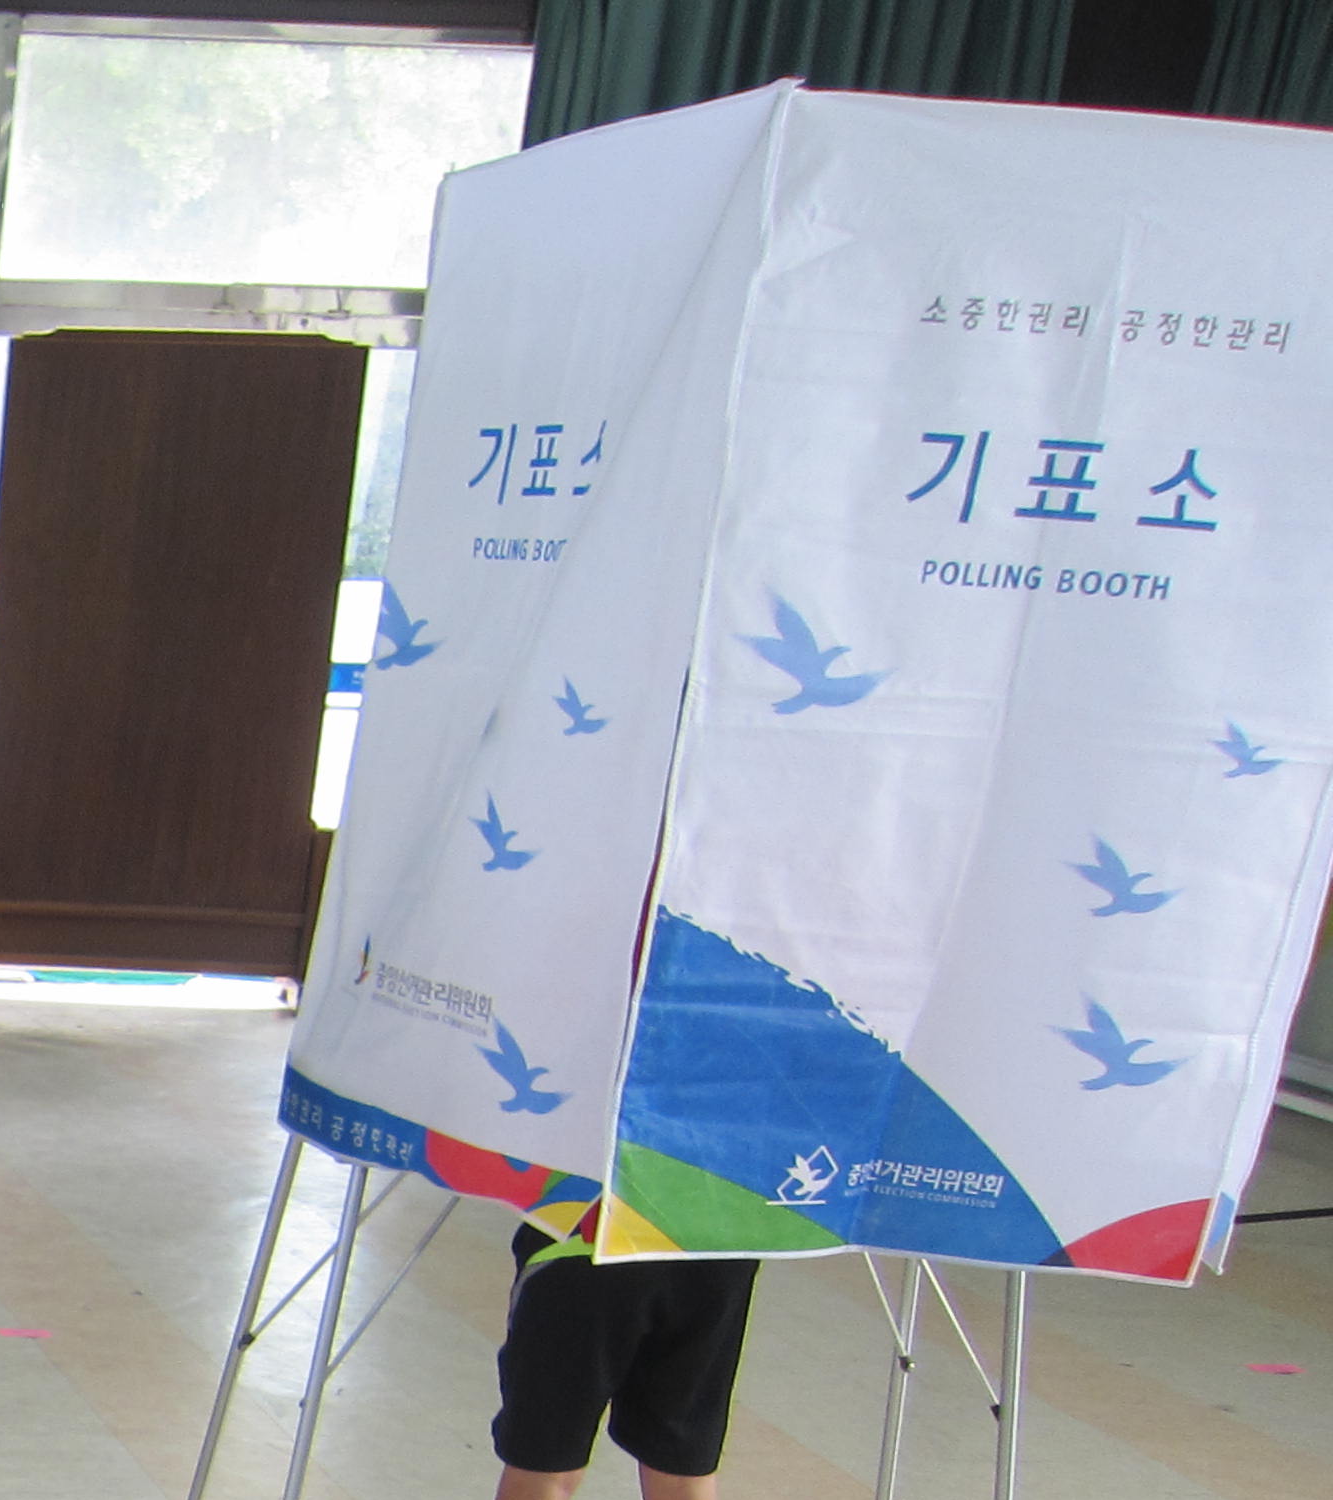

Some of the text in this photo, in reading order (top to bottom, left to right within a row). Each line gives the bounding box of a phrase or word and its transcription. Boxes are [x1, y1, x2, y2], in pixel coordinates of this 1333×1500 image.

[919, 295, 1292, 354] 소중한권리 공정한관리
[905, 430, 1219, 532] 기표소
[472, 537, 529, 561] POLLING
[921, 560, 1172, 601] POLLING BOOTH
